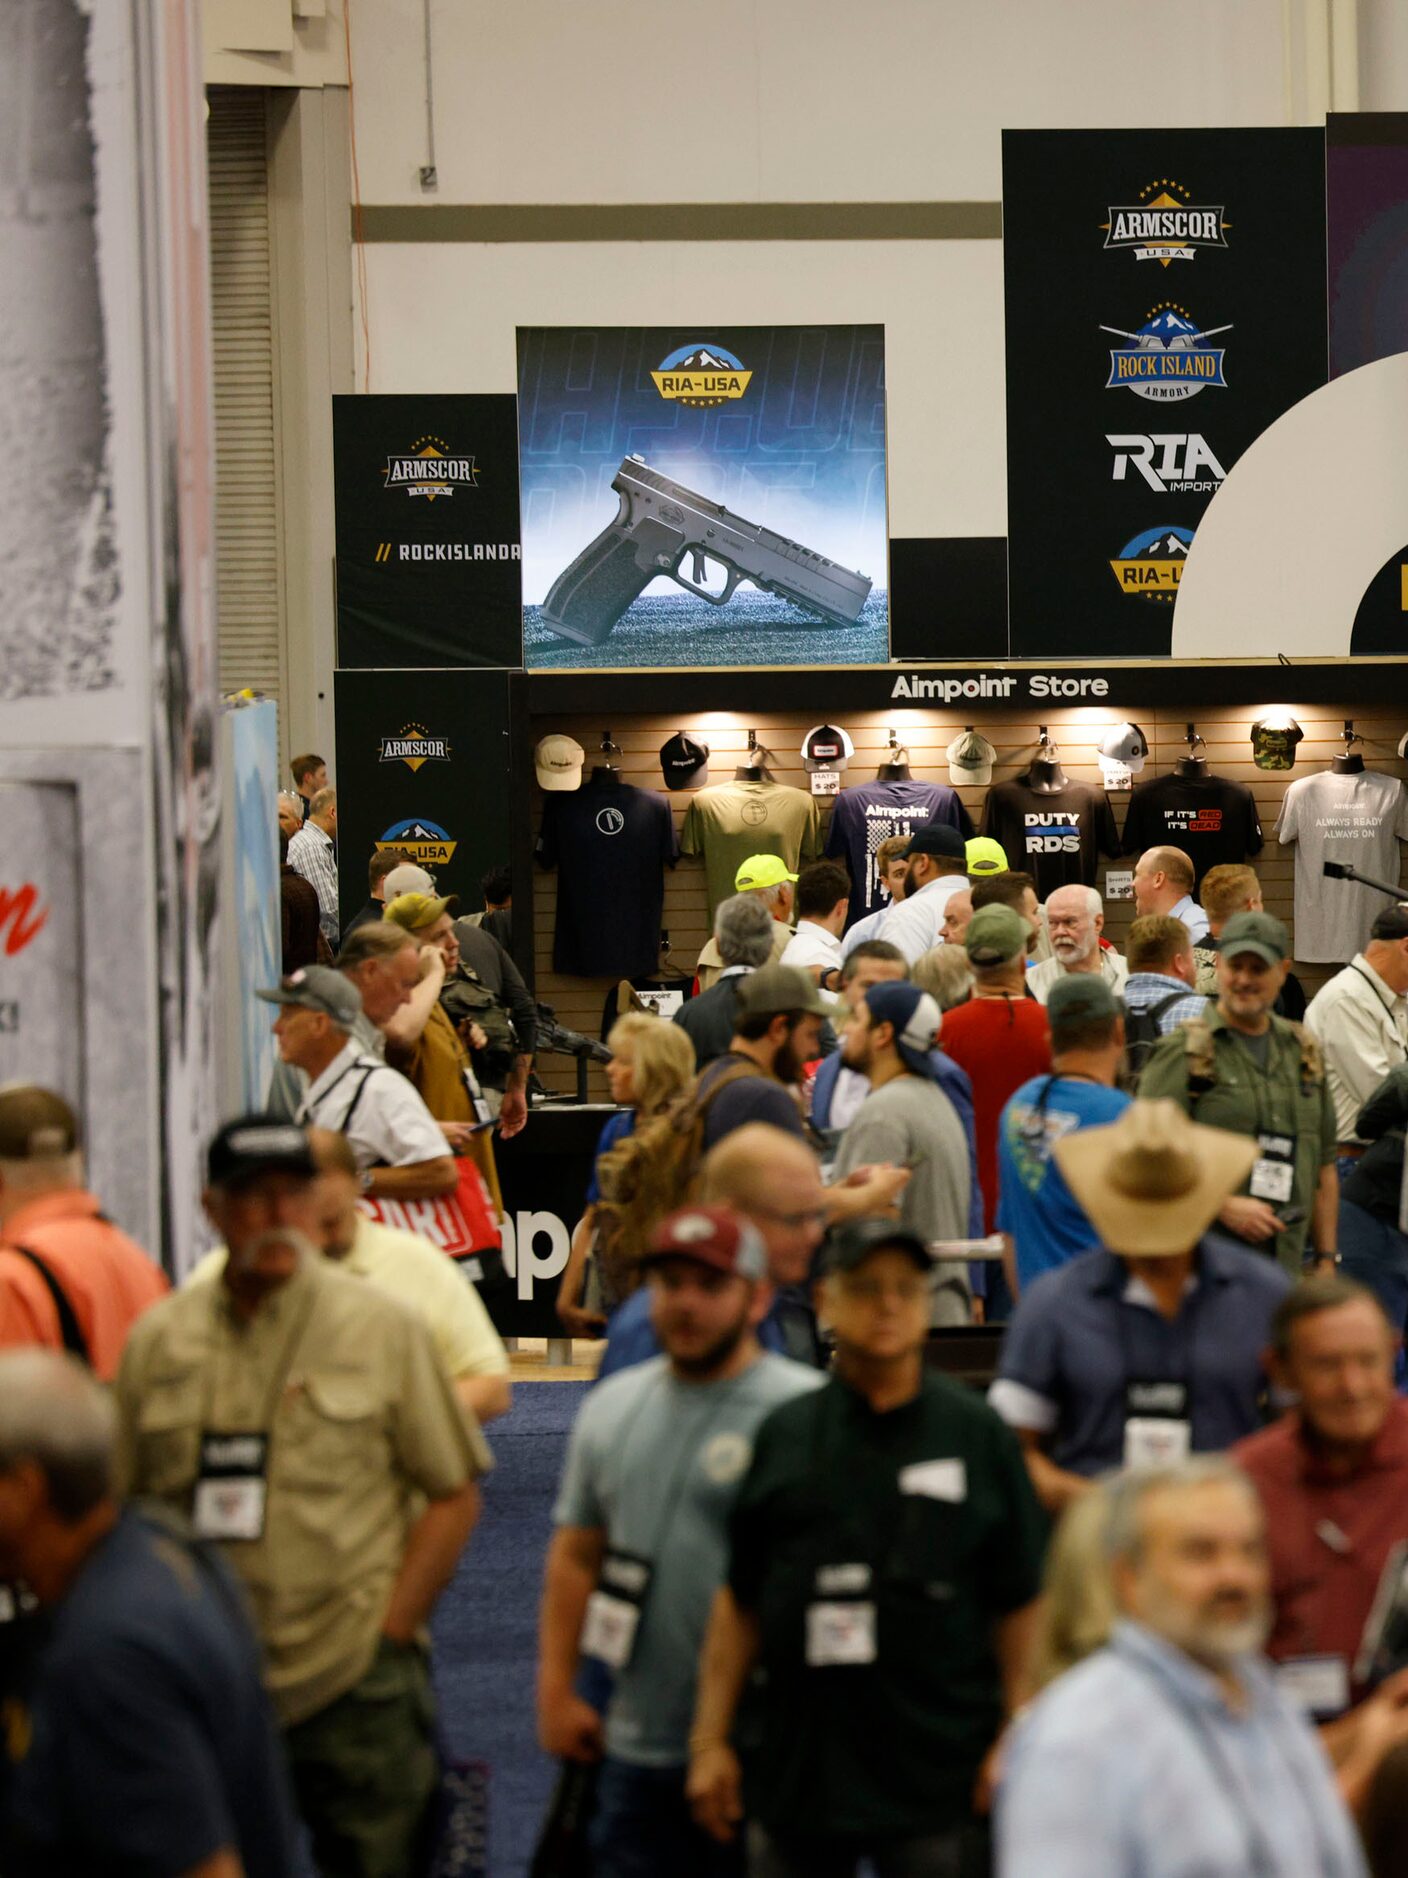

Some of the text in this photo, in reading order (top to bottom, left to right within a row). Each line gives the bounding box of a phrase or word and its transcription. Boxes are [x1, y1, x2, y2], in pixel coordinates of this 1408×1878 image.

[1112, 212, 1219, 240] ARMSCOR
[1146, 249, 1185, 257] USA
[1117, 355, 1216, 379] ROCK ISLAND
[662, 377, 742, 391] RIA-USA
[1144, 386, 1190, 398] ARMORY
[1104, 433, 1228, 492] RIA
[391, 460, 471, 481] ARMSCOR
[399, 543, 521, 561] ROCKISLANDA
[891, 674, 1109, 702] Aimpoint Store
[384, 741, 445, 757] ARMSCOR
[1024, 813, 1080, 827] DUTY
[1164, 810, 1174, 819] IF
[1177, 810, 1197, 819] IT'S
[1315, 816, 1383, 827] ALWAYS READY
[1167, 821, 1188, 830] IT'S
[1323, 829, 1375, 839] ALWAYS ON
[1025, 836, 1081, 853] RDS
